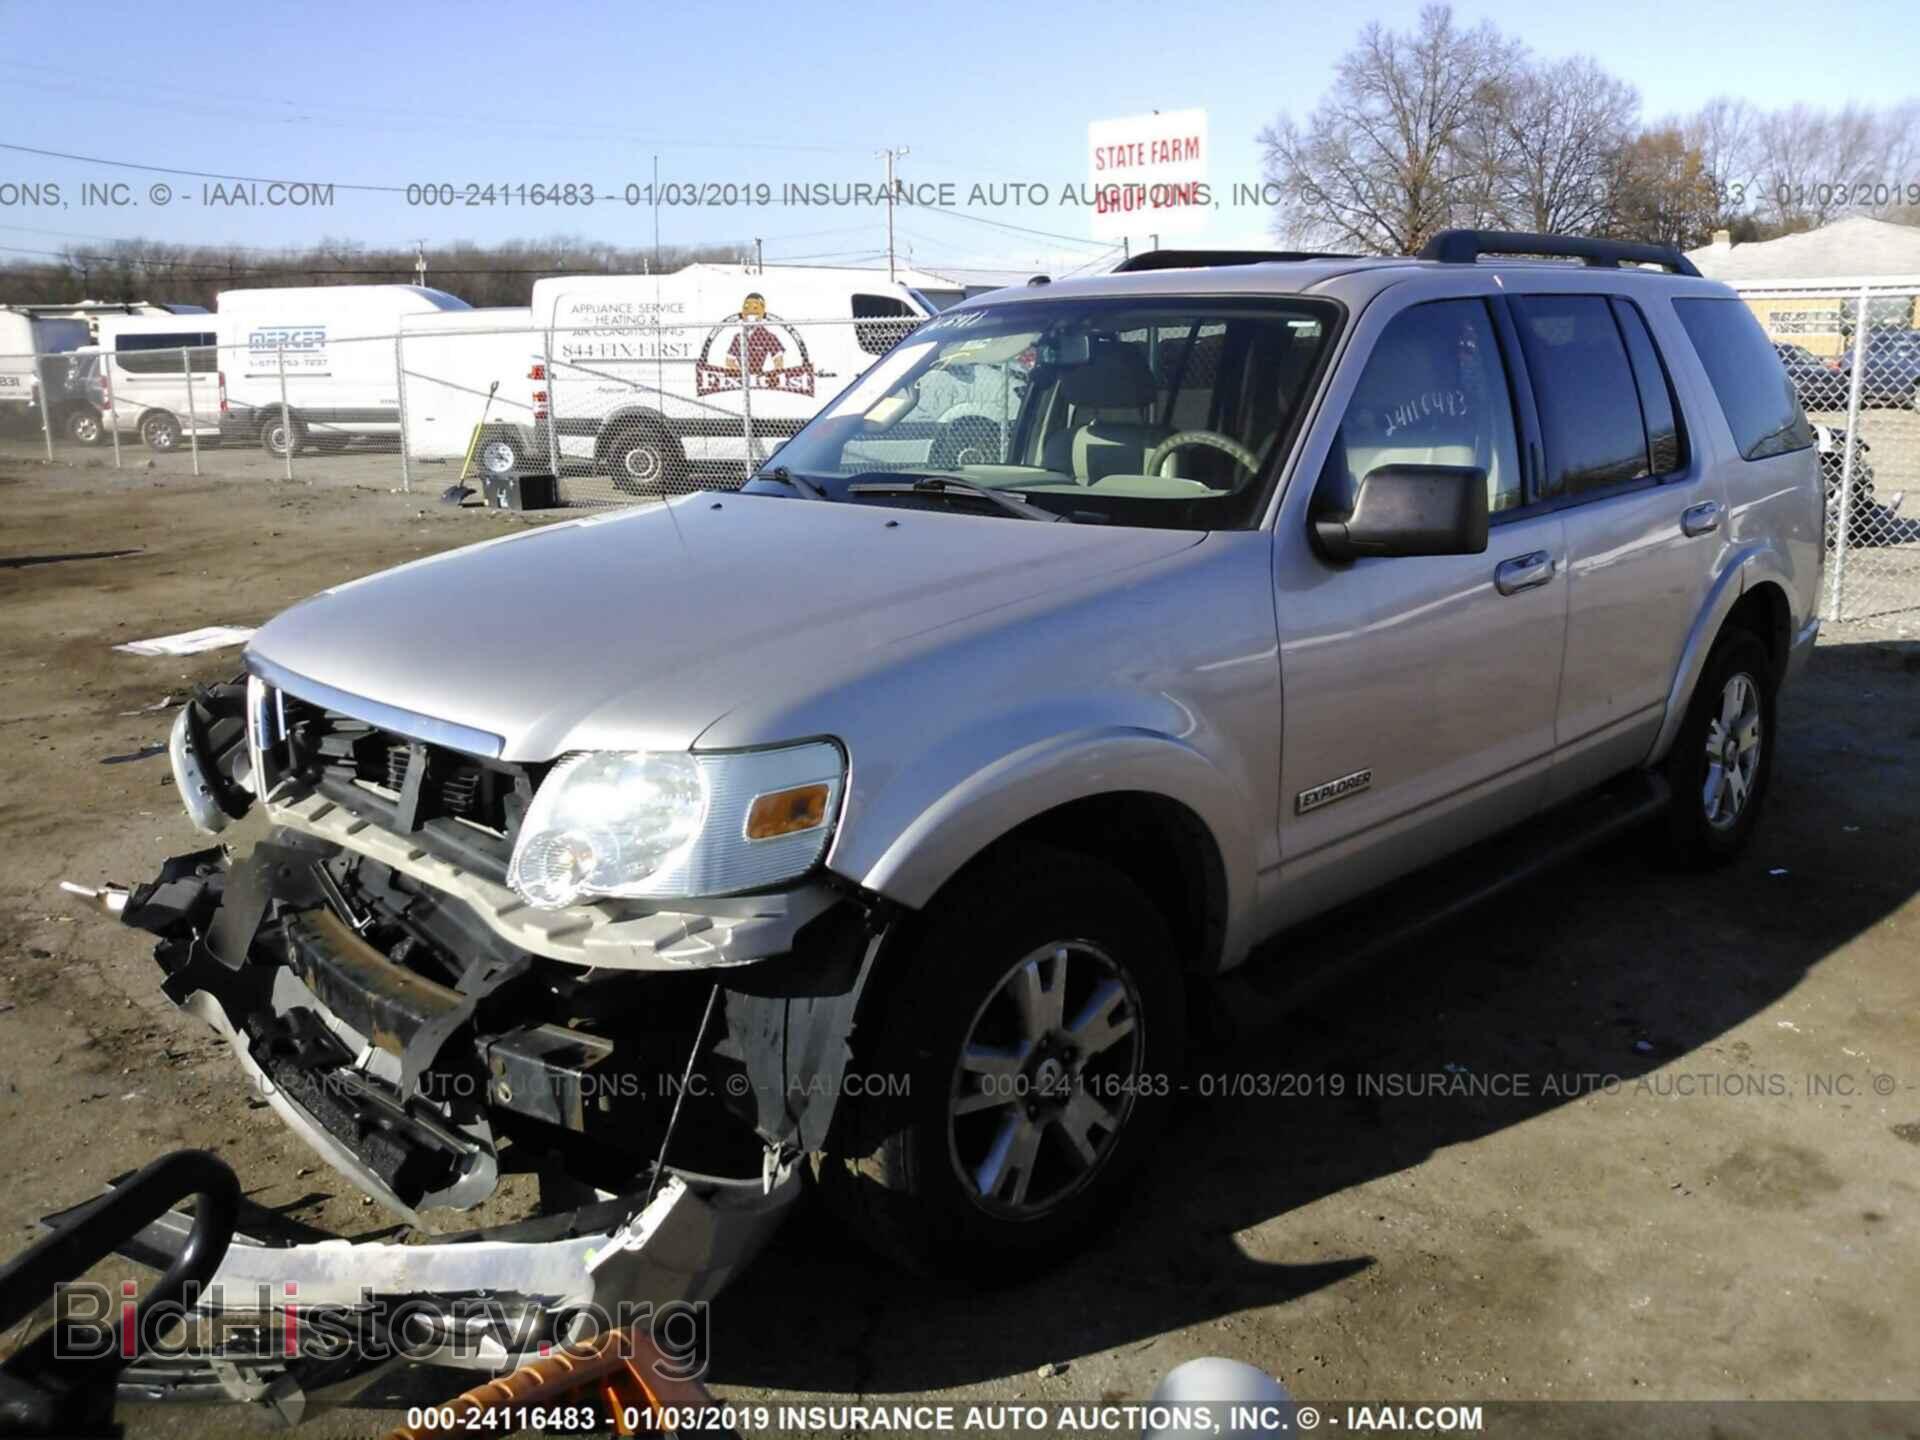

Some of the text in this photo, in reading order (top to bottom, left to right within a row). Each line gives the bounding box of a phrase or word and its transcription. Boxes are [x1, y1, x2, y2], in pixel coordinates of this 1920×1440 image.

[1095, 136, 1200, 171] STATE FARM
[571, 302, 685, 314] APPLIANCE SERVICE
[595, 315, 646, 326] HEATING
[1303, 772, 1371, 806] EXPLORER
